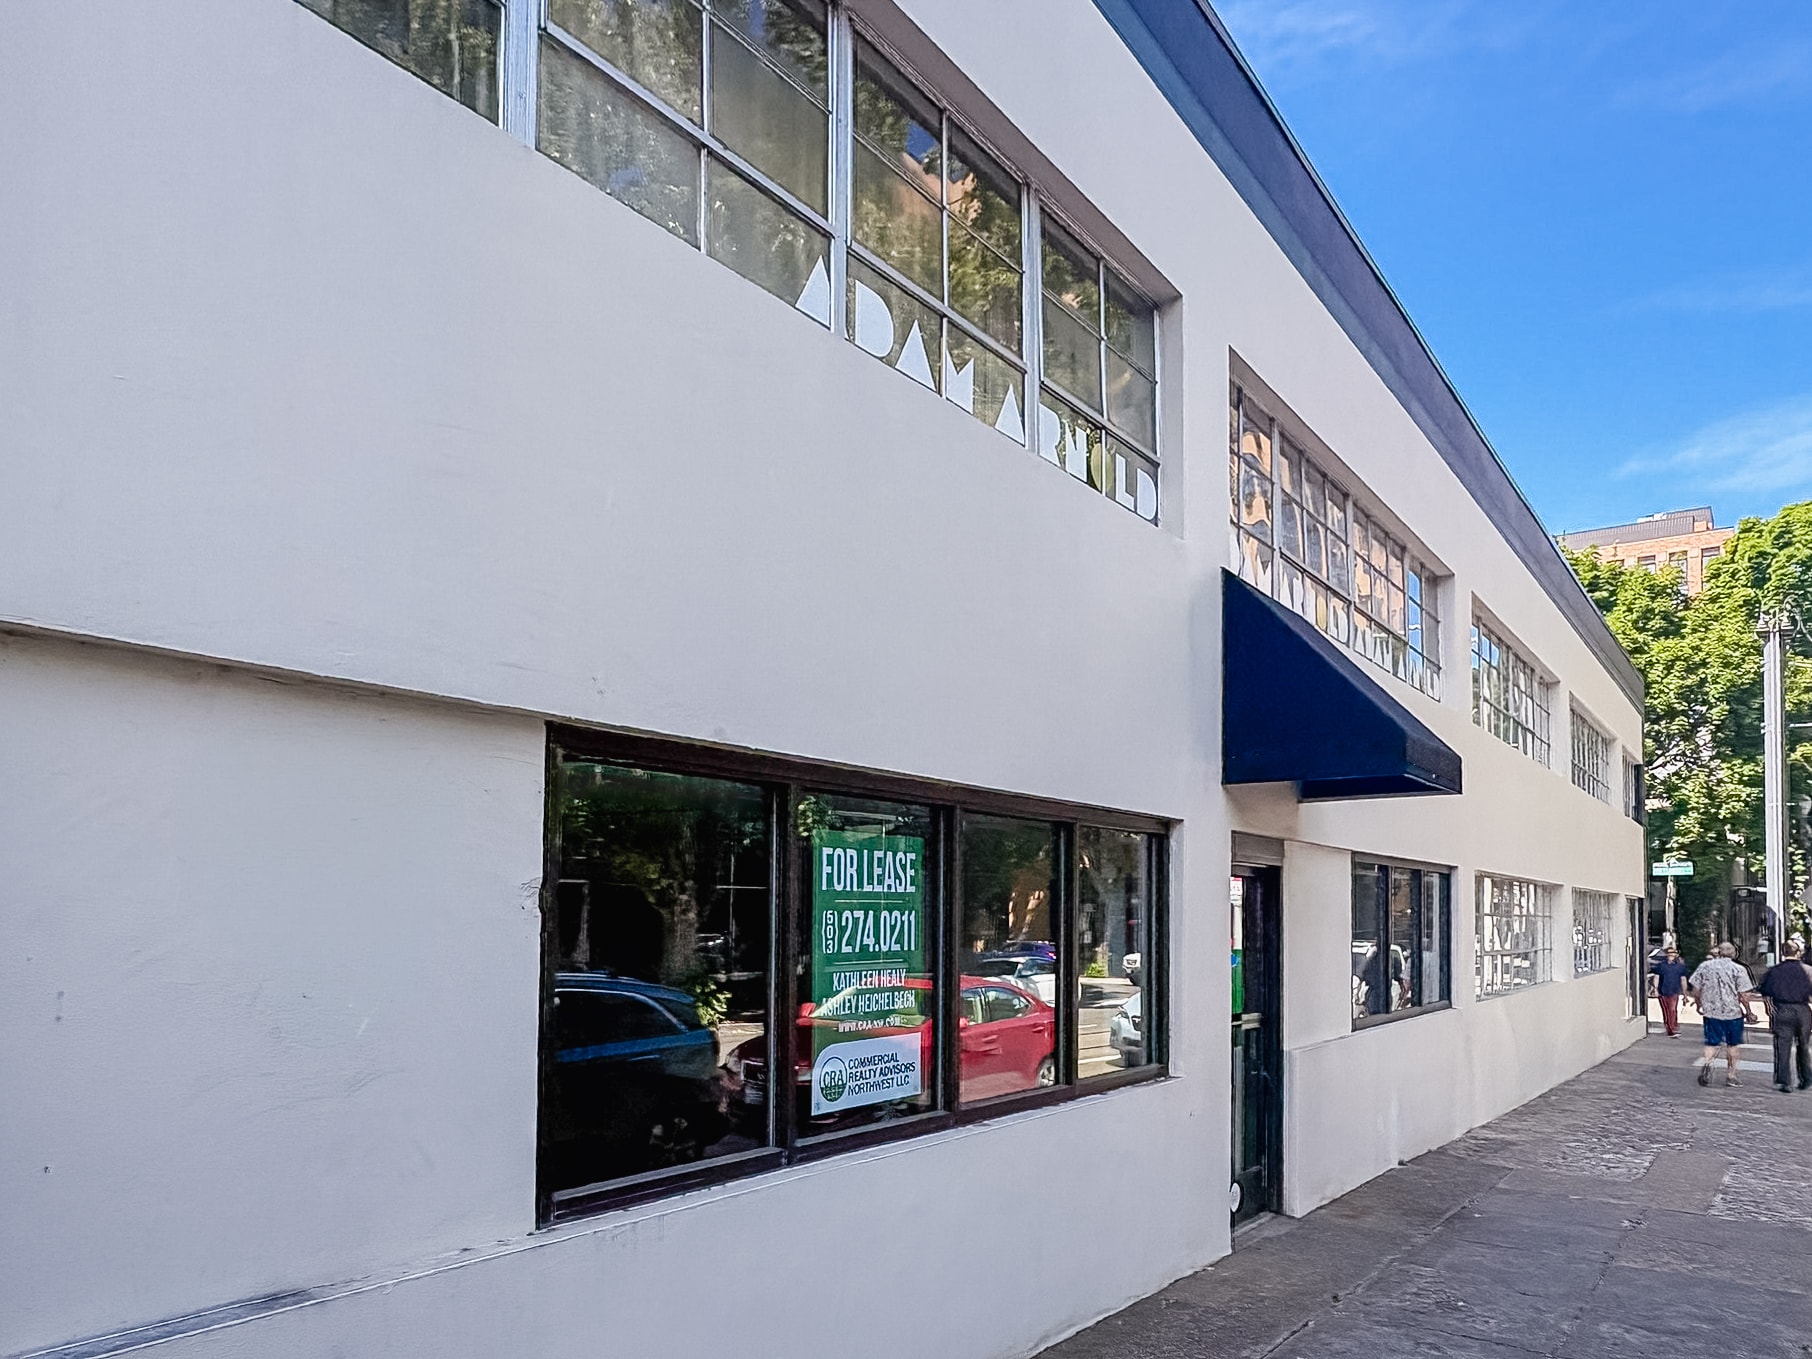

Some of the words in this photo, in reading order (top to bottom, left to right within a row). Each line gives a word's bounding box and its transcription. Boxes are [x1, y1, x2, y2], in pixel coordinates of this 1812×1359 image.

[795, 254, 975, 415] ADAM
[994, 382, 1157, 521] ARNOLD
[821, 846, 858, 891] FOR
[862, 849, 916, 893] LEASE
[841, 910, 916, 953] 274.0211
[833, 970, 879, 992] KATHLEEN
[880, 968, 907, 988] HEALY
[821, 994, 857, 1017] ASHLEY
[848, 1052, 900, 1070] COMMERCIAL
[848, 1066, 879, 1083] REALTY
[879, 1062, 916, 1080] ADVISORS
[823, 1069, 844, 1088] CRA
[847, 1079, 894, 1097] NORTHWEST
[895, 1074, 910, 1088] LLC
